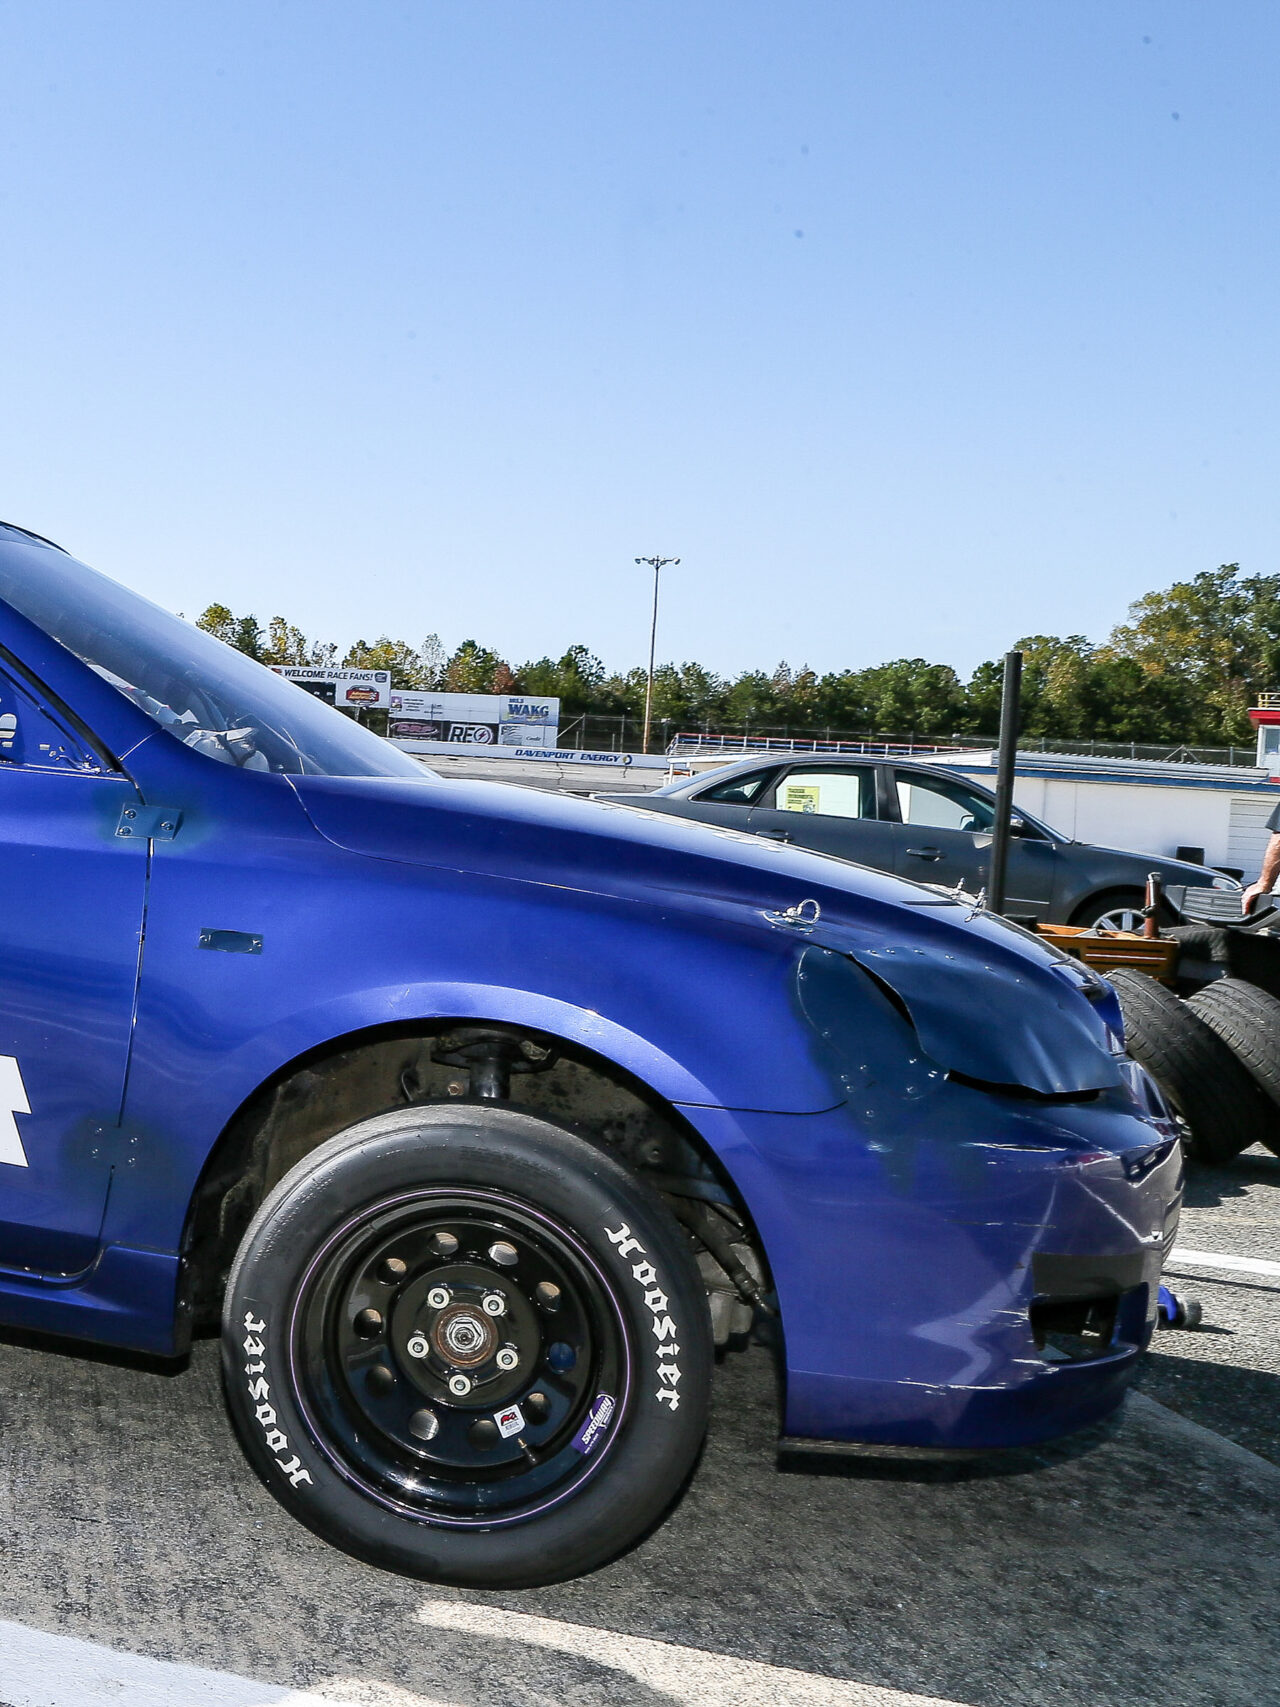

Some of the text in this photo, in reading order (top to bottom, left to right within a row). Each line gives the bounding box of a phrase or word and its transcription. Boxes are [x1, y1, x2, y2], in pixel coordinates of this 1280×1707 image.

[284, 668, 326, 679] WELCOME
[327, 671, 349, 680] RACE
[349, 672, 374, 681] FANS!
[507, 703, 550, 717] WAKG
[515, 749, 621, 763] DAVENPORT ENERGY
[603, 1221, 682, 1412] Hoosier
[242, 1310, 314, 1490] Hoosier
[581, 1396, 613, 1445] SPEEDWAY
